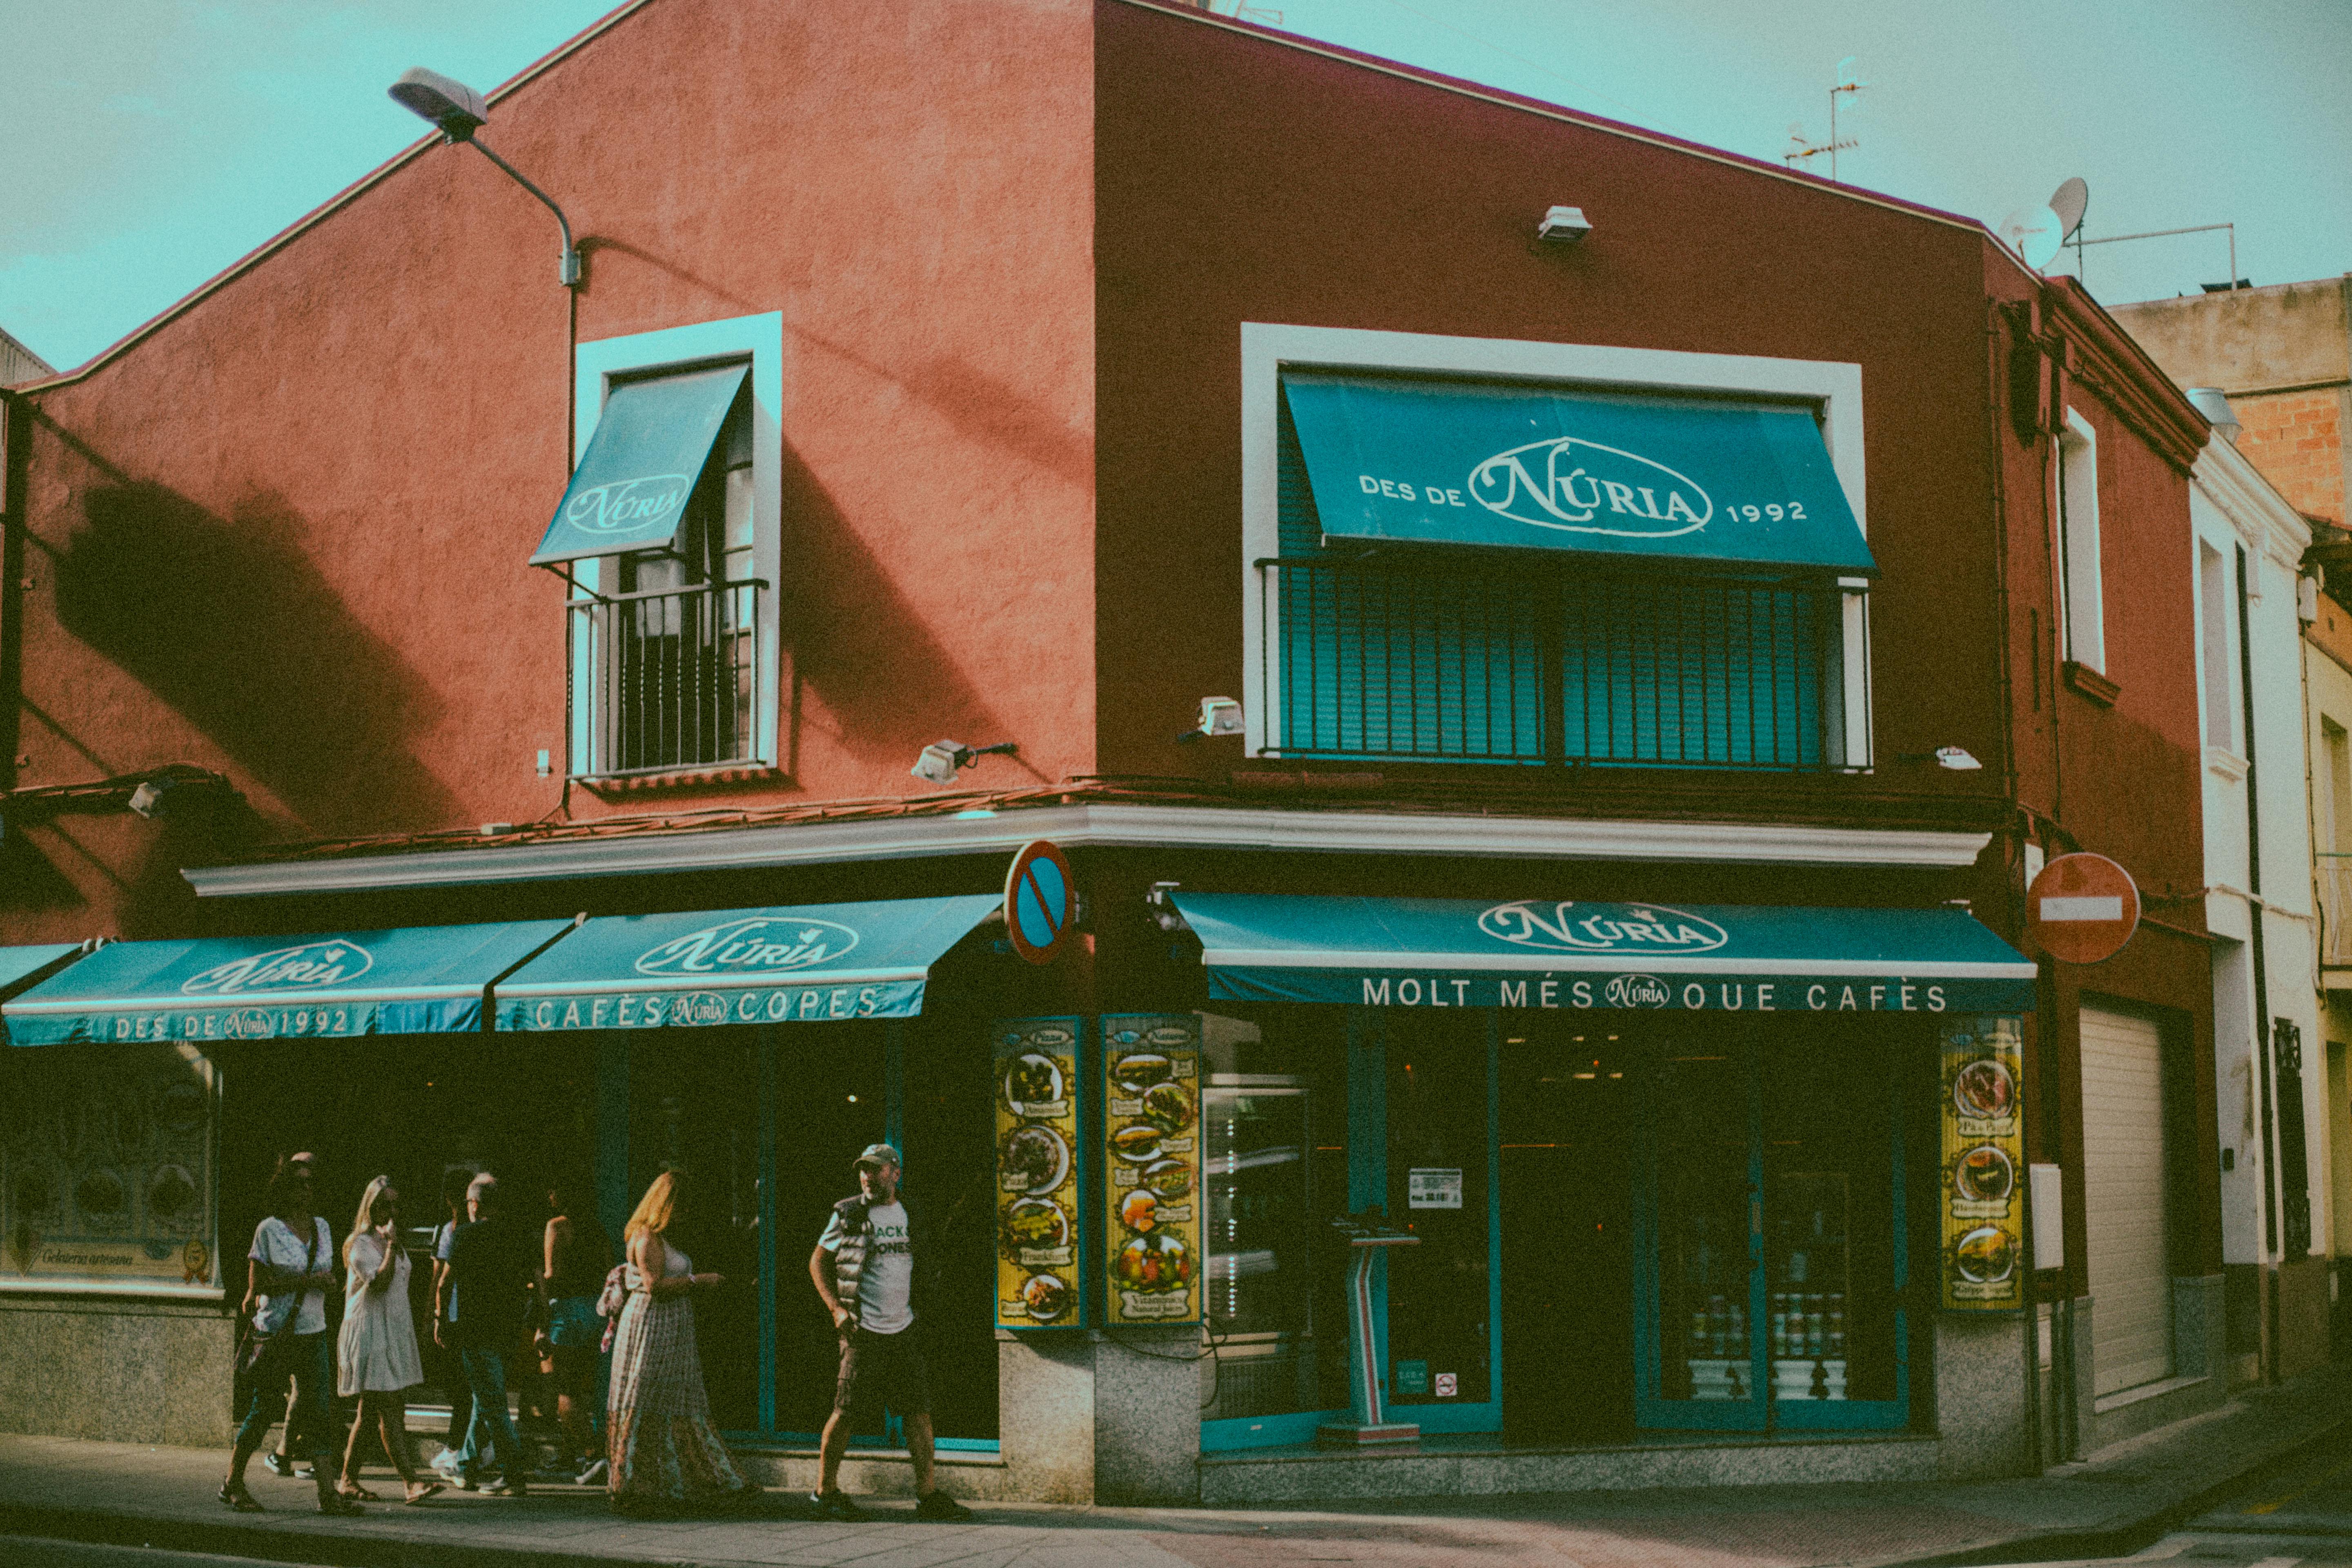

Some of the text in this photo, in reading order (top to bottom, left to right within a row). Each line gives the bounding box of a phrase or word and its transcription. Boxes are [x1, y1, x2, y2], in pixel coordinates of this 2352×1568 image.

[1359, 475, 1416, 501] DES
[1425, 486, 1466, 507] DE
[1726, 501, 1807, 523] 1992
[536, 993, 662, 1029] CAFÈS
[738, 988, 876, 1021] COPES
[1363, 978, 1470, 1006] MOLT
[1501, 973, 1593, 1009] MÉS
[1683, 983, 1775, 1011] QUE
[1807, 978, 1946, 1012] CAFÈS
[116, 1016, 164, 1039] DES
[185, 1015, 216, 1037] DE
[282, 1010, 346, 1033] 1992
[876, 1226, 904, 1237] ACK
[876, 1242, 911, 1255] ONES
